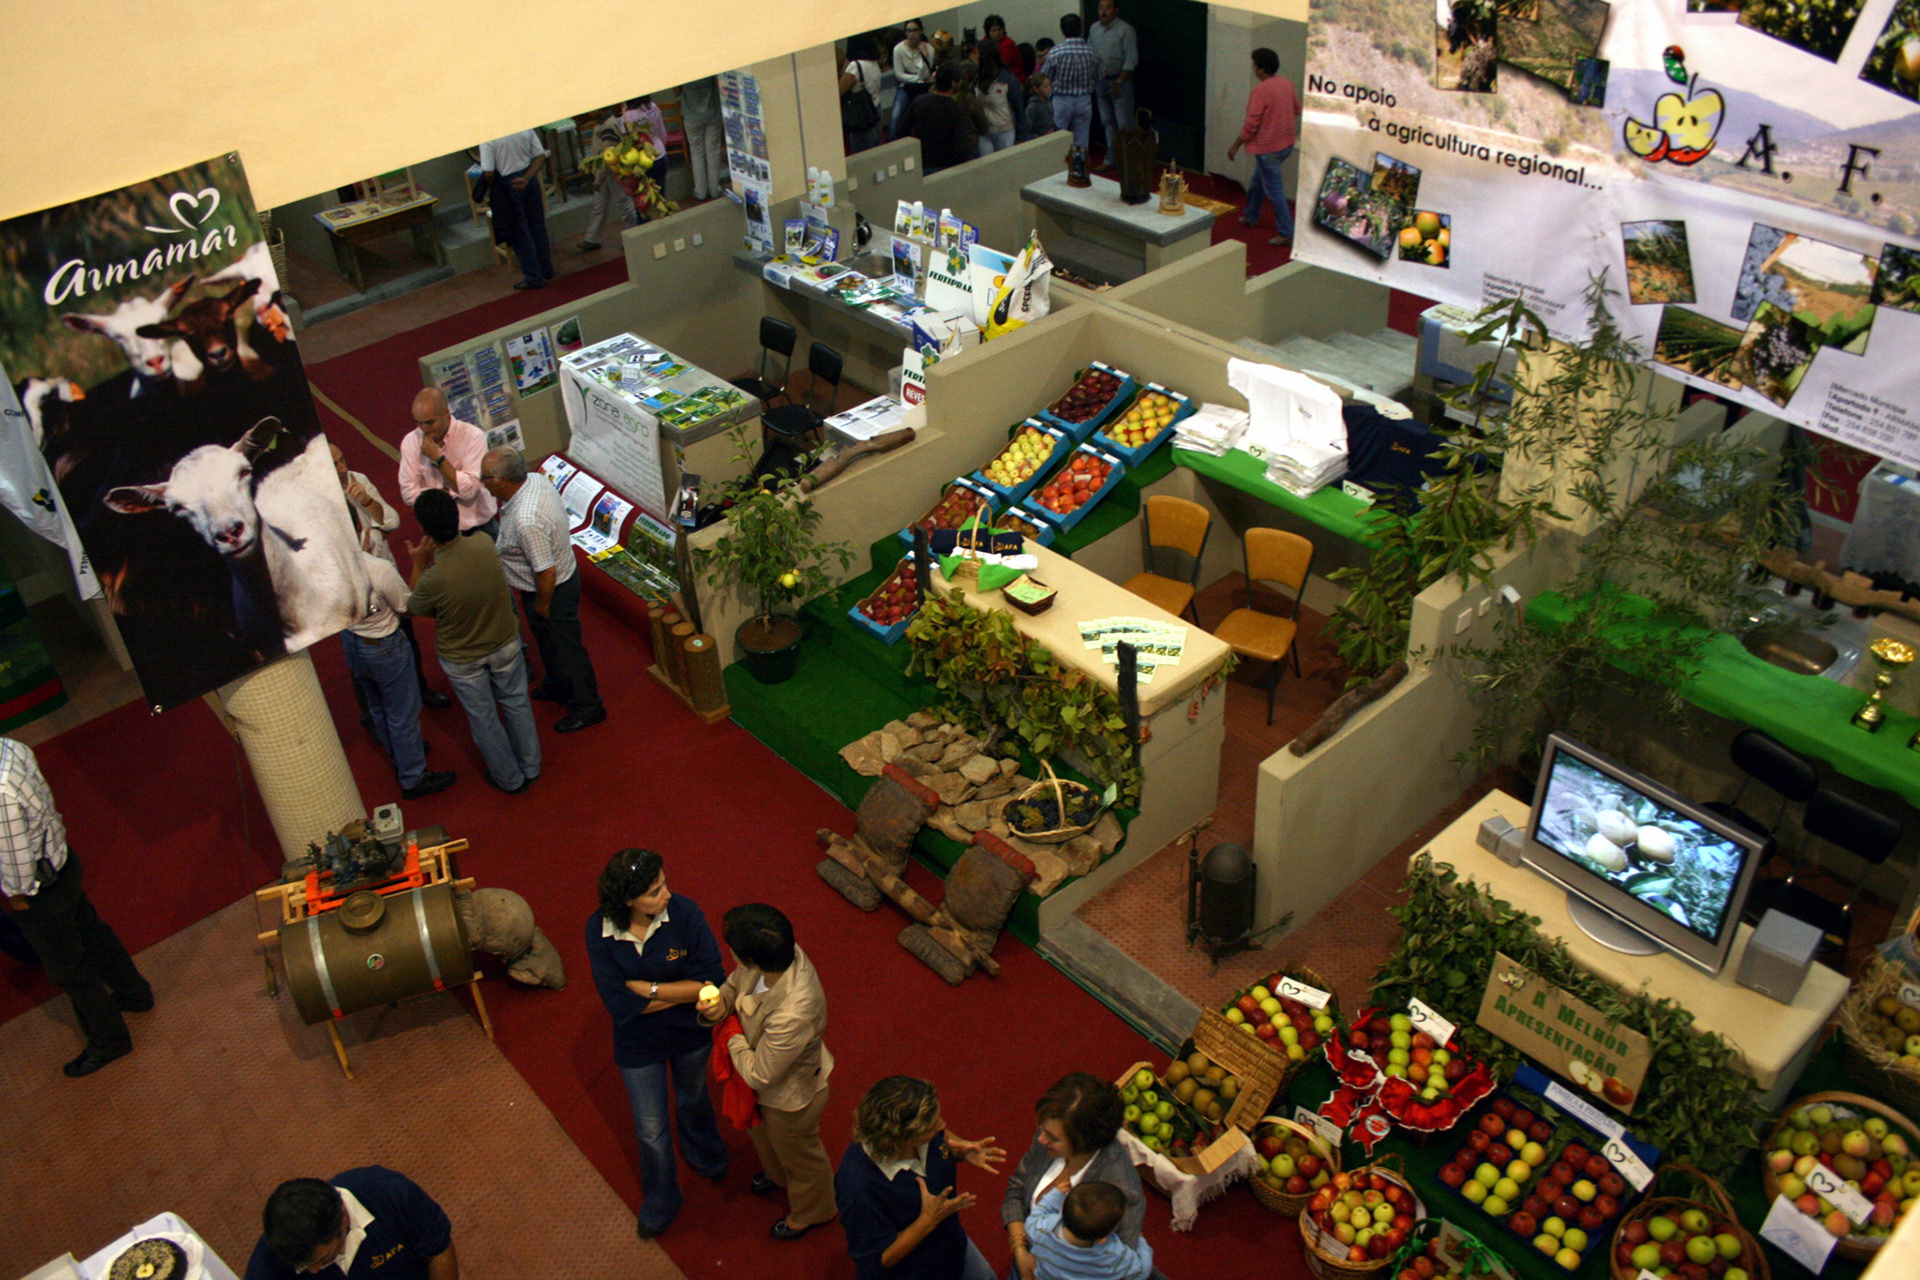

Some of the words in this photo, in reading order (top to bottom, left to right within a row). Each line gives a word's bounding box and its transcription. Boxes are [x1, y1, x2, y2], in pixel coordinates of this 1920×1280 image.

[1308, 74, 1336, 94] No
[1343, 82, 1397, 108] apoio
[1368, 111, 1380, 131] à
[1386, 122, 1490, 161] agricultura
[1496, 151, 1603, 191] regional...
[44, 224, 237, 305] Armamar
[1494, 994, 1618, 1077] APRESENTAÇÃO
[1531, 990, 1547, 1010] A
[1557, 1004, 1629, 1057] MELHOR
